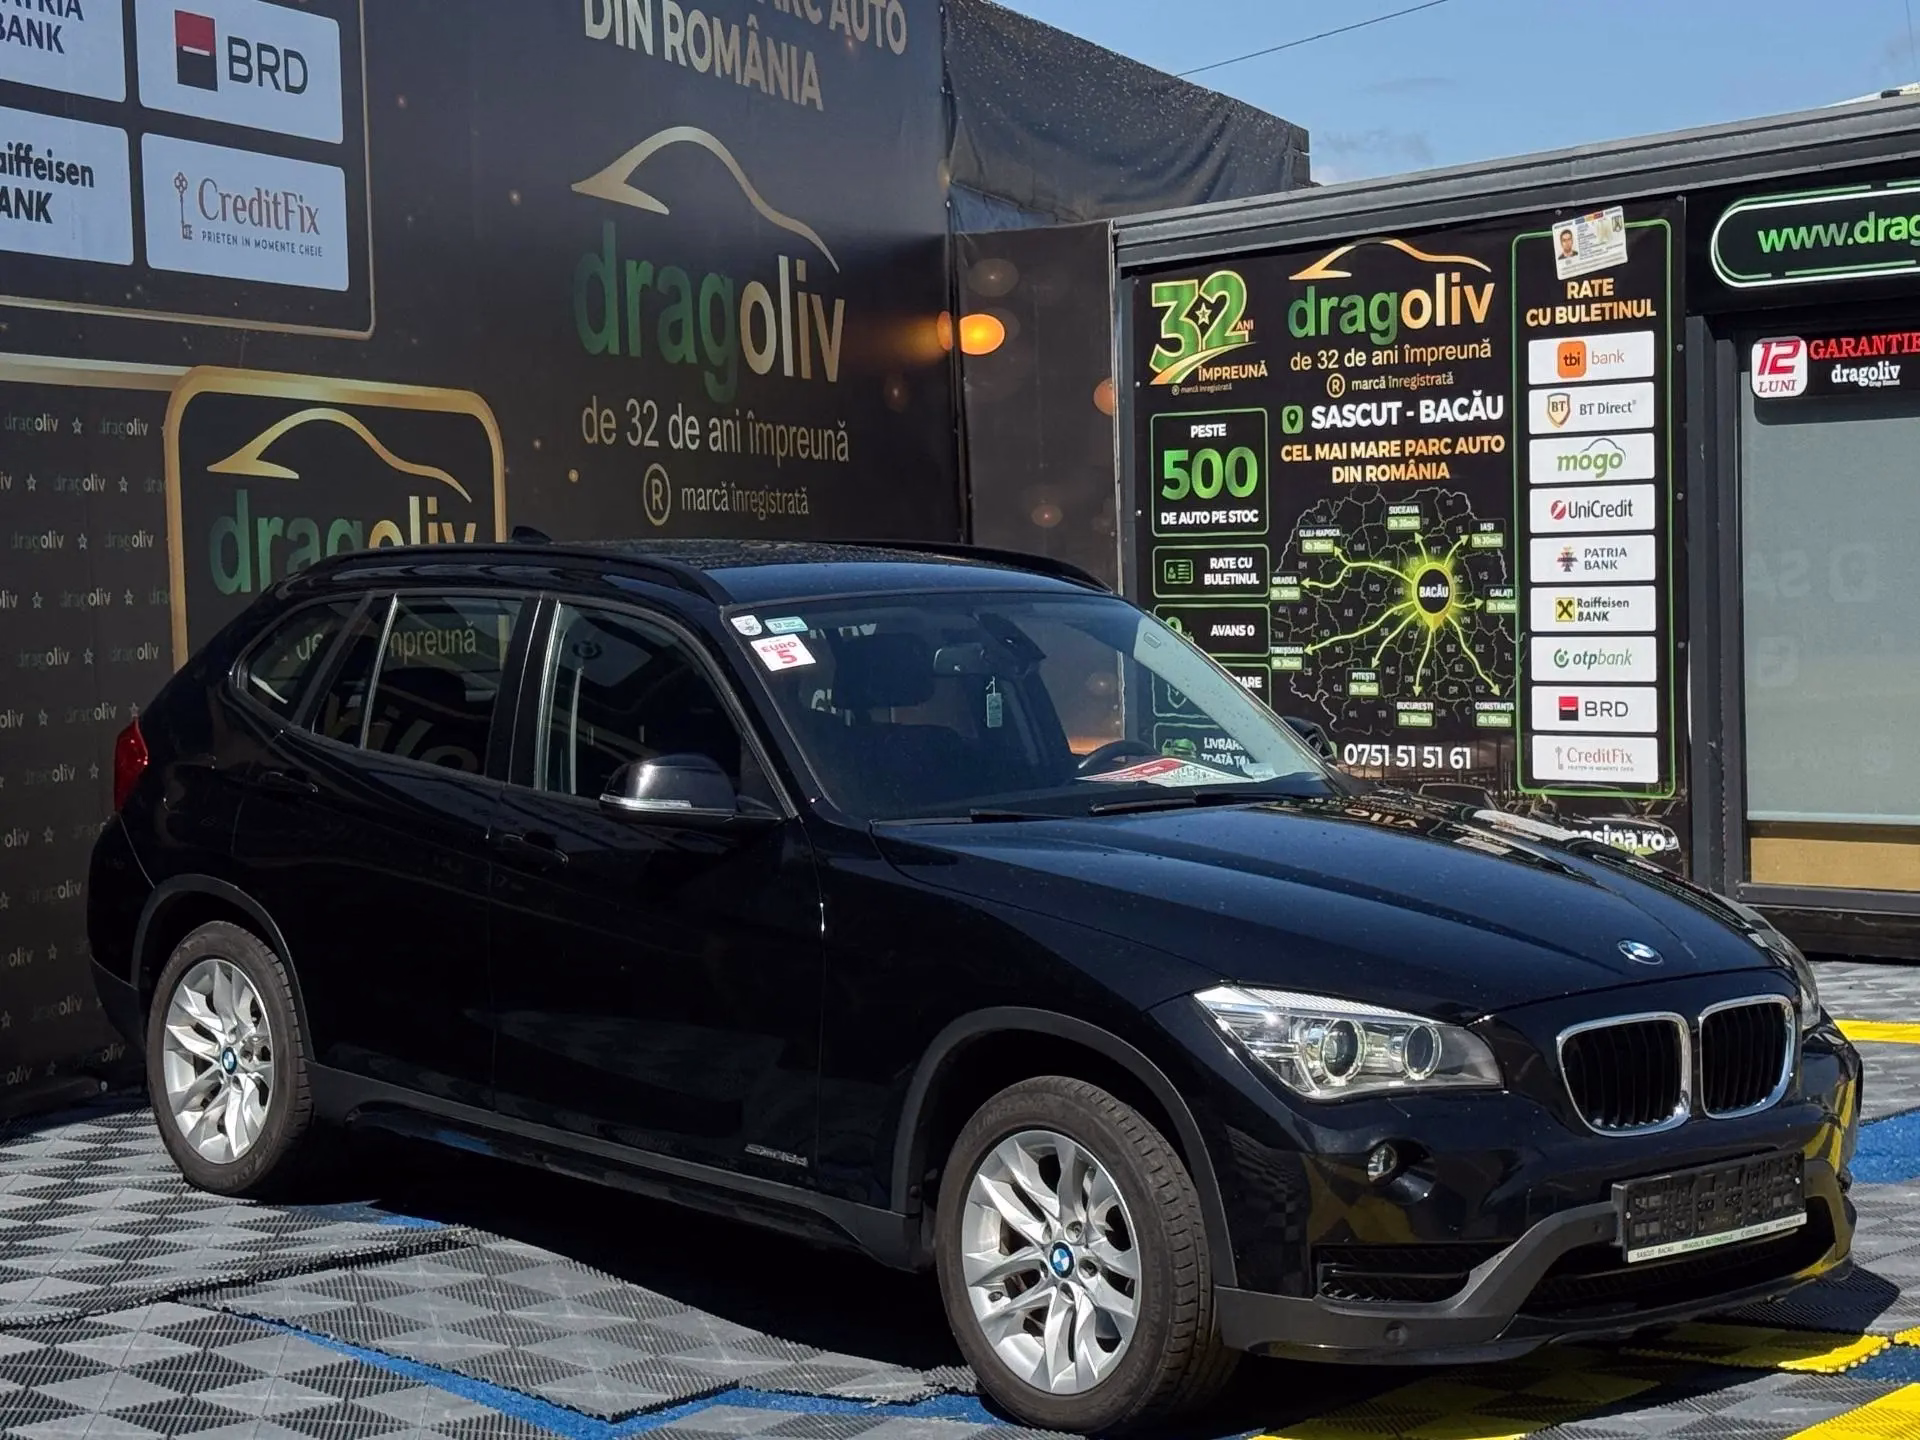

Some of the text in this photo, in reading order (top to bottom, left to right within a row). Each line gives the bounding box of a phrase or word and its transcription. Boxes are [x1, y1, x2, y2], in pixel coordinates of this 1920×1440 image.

[829, 0, 907, 56] AUTO
[227, 35, 309, 95] BRD
[585, 0, 824, 111] DIN ROMÂNIA
[0, 141, 95, 188] aiffeisen
[0, 186, 53, 224] ANK
[198, 178, 321, 237] CreditFix
[201, 230, 323, 257] PRIETEN IN MOMENTE CHEIE
[1566, 277, 1615, 299] RATE
[573, 220, 846, 404] dragoliv
[1288, 271, 1496, 346] dragoliv
[1526, 298, 1657, 327] CU BULETINUL
[1149, 270, 1254, 373] 32 ANI
[1290, 338, 1492, 371] de 32 de ani împreună
[1563, 350, 1625, 367] tbi bank
[1757, 339, 1801, 376] 12
[1198, 360, 1268, 382] ÎMPREUNĂ
[1351, 375, 1386, 391] marcă
[1388, 372, 1454, 390] înregistrată
[1831, 360, 1901, 387] dragoliv
[1758, 379, 1797, 393] LUNI
[1311, 401, 1403, 430] SASCUT
[1418, 389, 1505, 424] BACĂU
[1551, 400, 1566, 413] BT
[1579, 404, 1594, 416] BT
[4, 412, 149, 440] dragoliv dragoliv
[581, 395, 849, 468] de 32 de ani împreună
[1190, 423, 1227, 438] PESTE
[1280, 435, 1506, 462] CEL MAI MARE PARC AUTO
[1161, 446, 1259, 501] 500
[1331, 459, 1451, 483] DIN ROMÂNIA
[1557, 452, 1624, 479] mogo
[681, 481, 730, 512] marcă
[731, 481, 809, 521] înregistrată
[1568, 499, 1633, 519] UniCredit
[1160, 509, 1259, 525] DE AUTO PE STOC
[10, 529, 65, 554] dragoliv
[1584, 547, 1627, 558] PATRIA
[1210, 556, 1253, 570] RATE CU
[1584, 560, 1618, 571] BANK
[1204, 572, 1260, 586] BULETINUL
[1419, 583, 1449, 598] BACĂU
[1577, 597, 1630, 609] Raiffeisen
[1577, 611, 1610, 622] BANK
[1210, 624, 1246, 637] AVANS
[390, 620, 477, 666] mpreună
[760, 641, 797, 653] EURO
[777, 650, 798, 664] 5
[1573, 648, 1633, 670] otpbank
[0, 708, 24, 729] oliv
[1584, 700, 1629, 717] BRD
[1343, 743, 1471, 770] 0751 51 51 61
[1567, 746, 1633, 765] CreditFix
